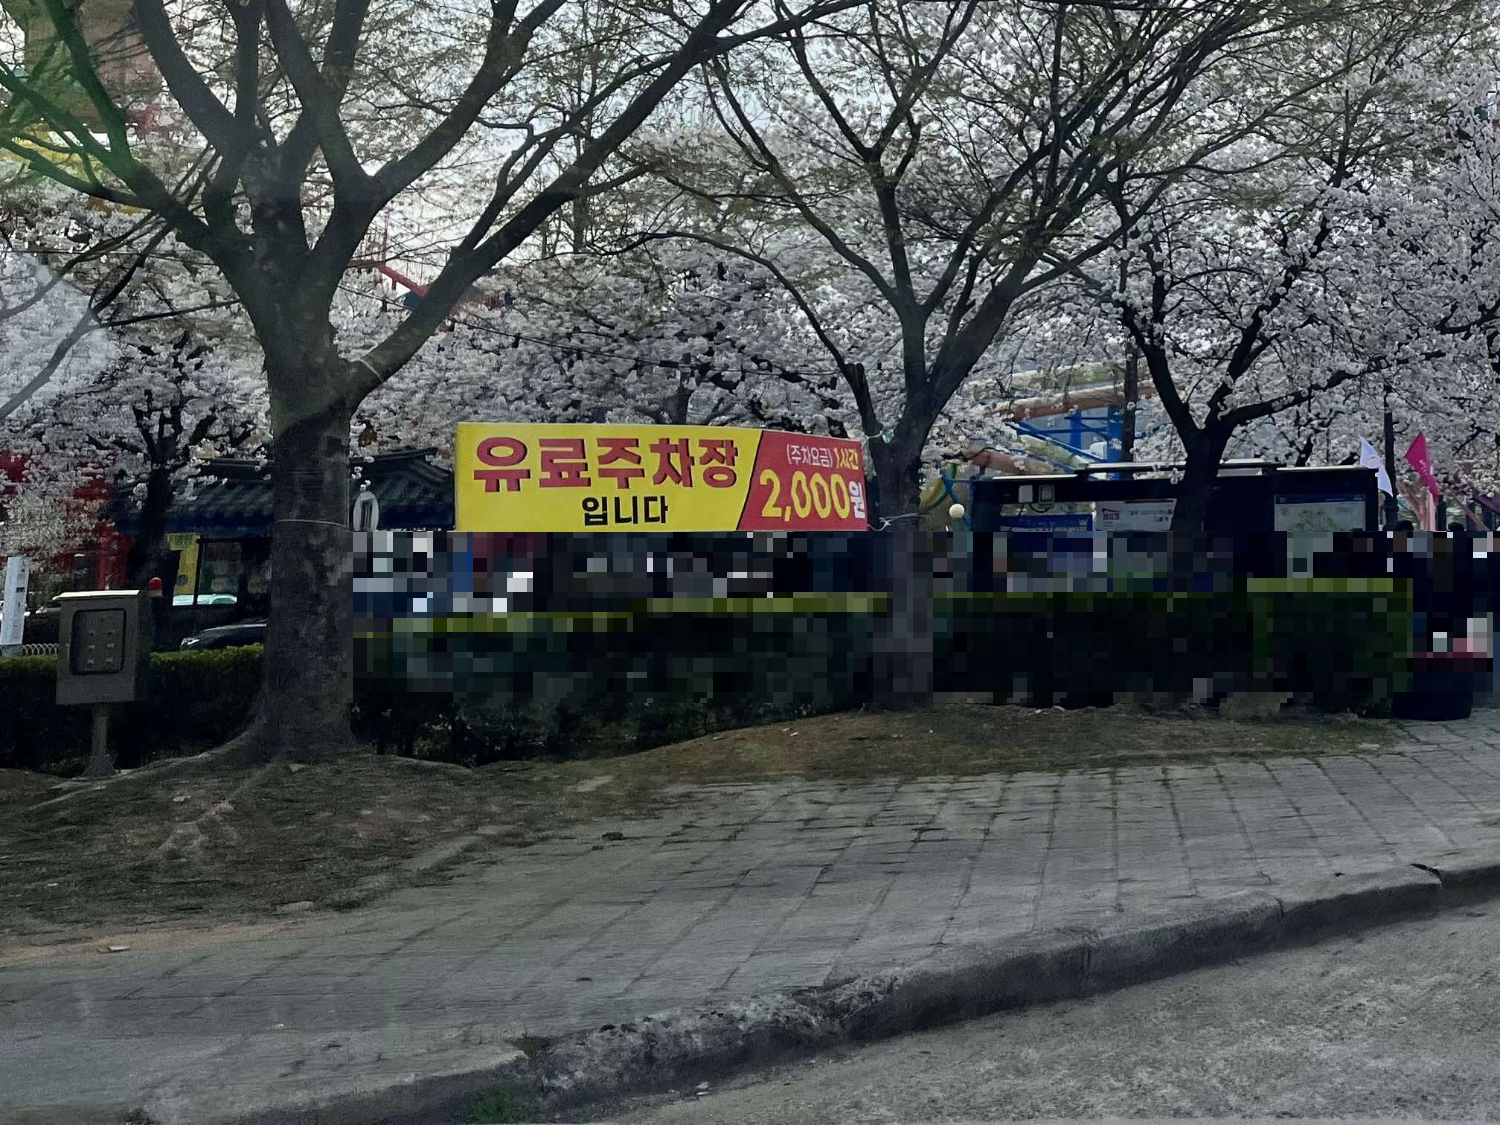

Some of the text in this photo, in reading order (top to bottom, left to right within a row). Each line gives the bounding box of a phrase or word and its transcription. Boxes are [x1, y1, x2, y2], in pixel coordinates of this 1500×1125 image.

[473, 436, 739, 493] 유료주차장
[786, 443, 860, 470] (주차요금) 1시간
[581, 495, 669, 526] 입니다
[760, 469, 866, 522] 2,000원
